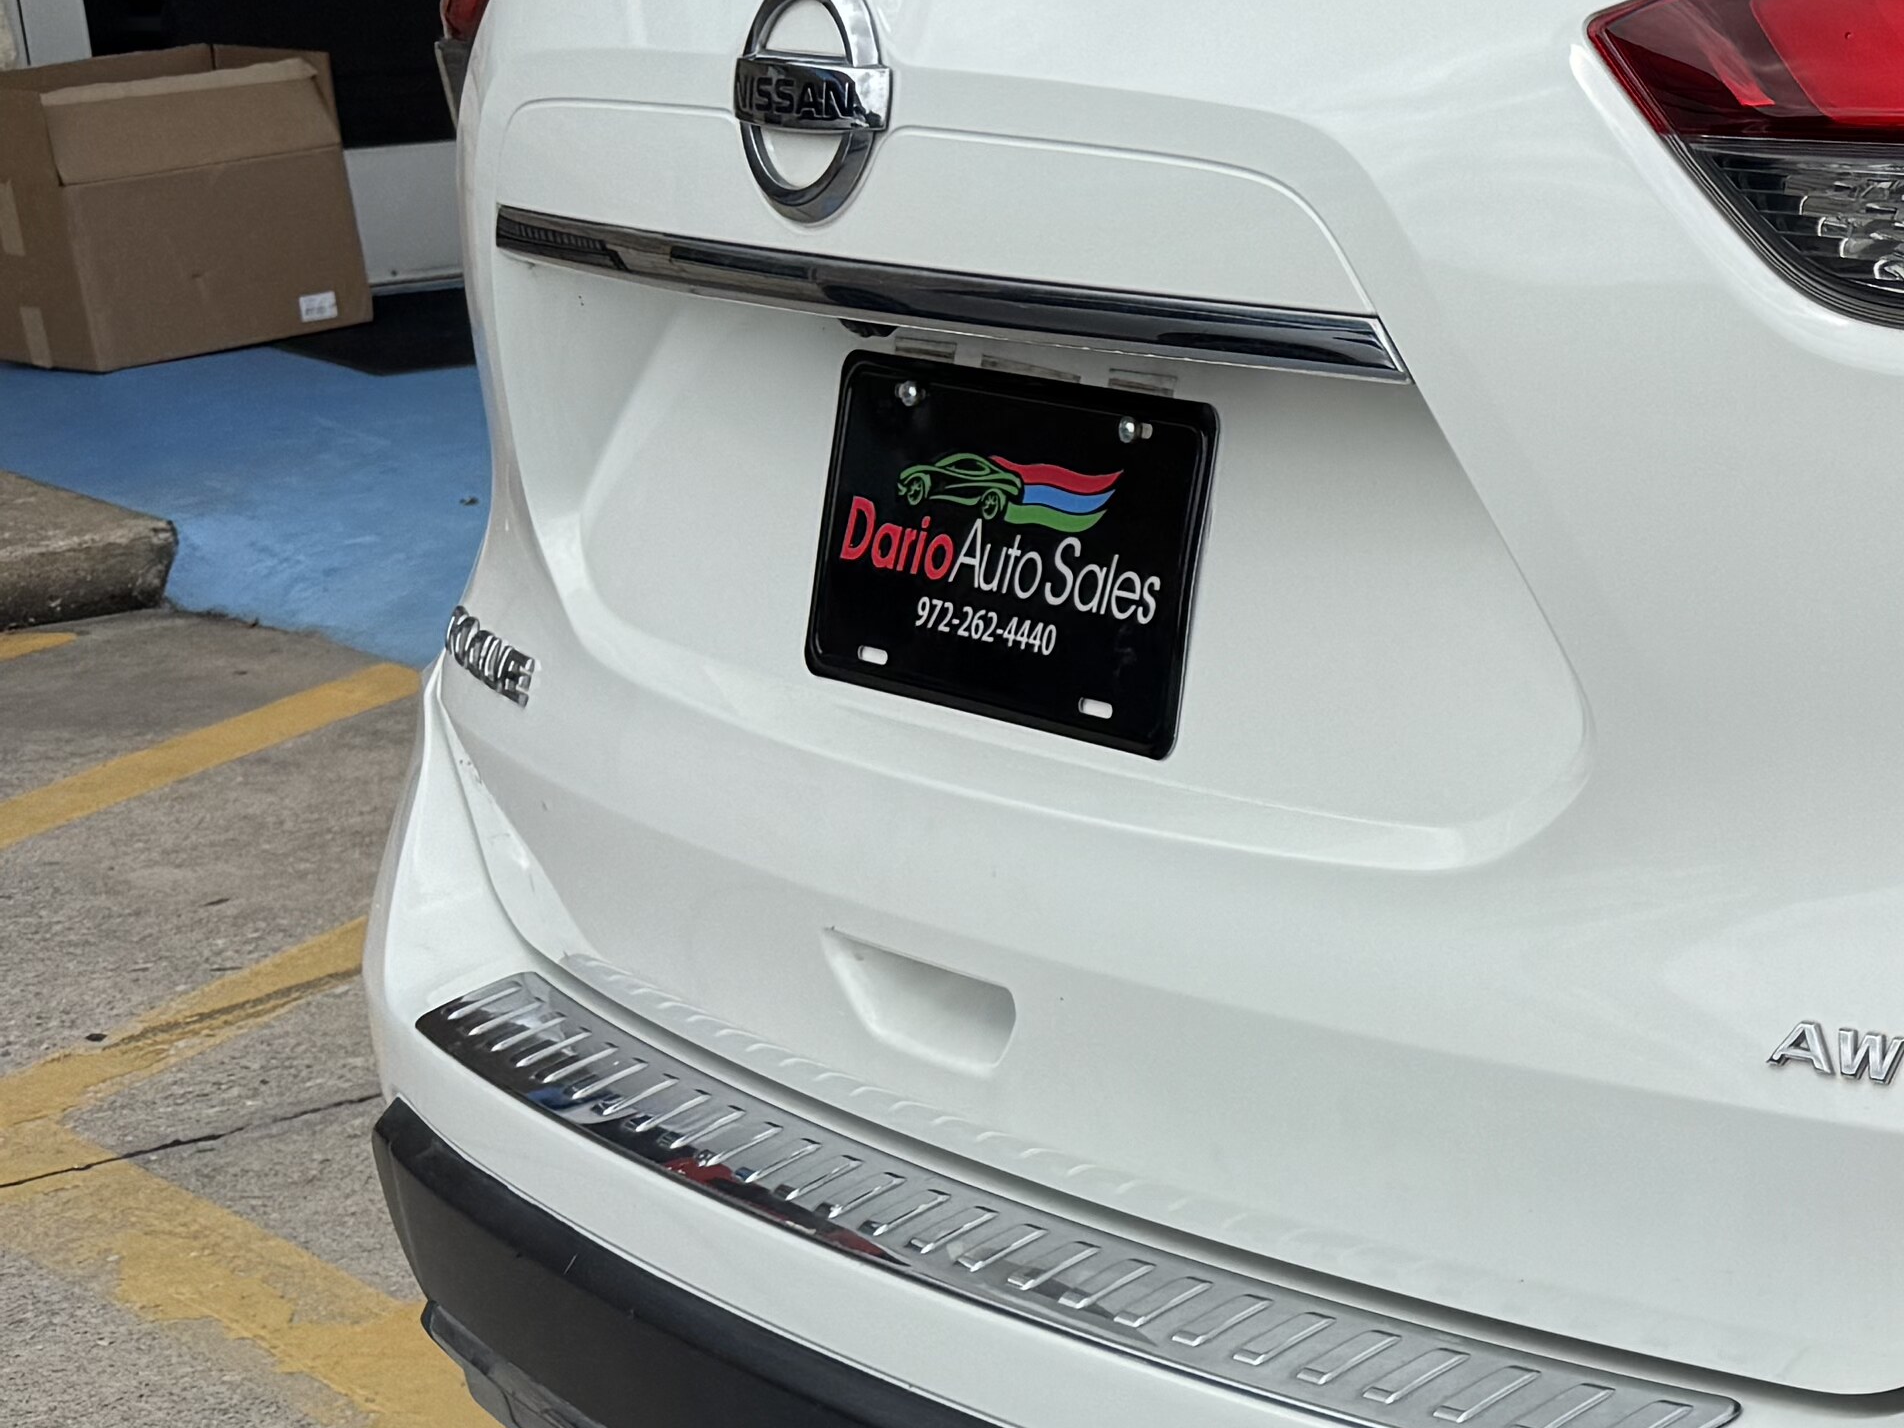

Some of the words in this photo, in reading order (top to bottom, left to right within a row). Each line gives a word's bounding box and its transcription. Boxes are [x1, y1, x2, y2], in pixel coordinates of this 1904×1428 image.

[735, 75, 852, 119] NISSAN
[840, 495, 955, 581] Dario
[1044, 536, 1161, 625] Sales
[914, 596, 1058, 656] 972-262-4440
